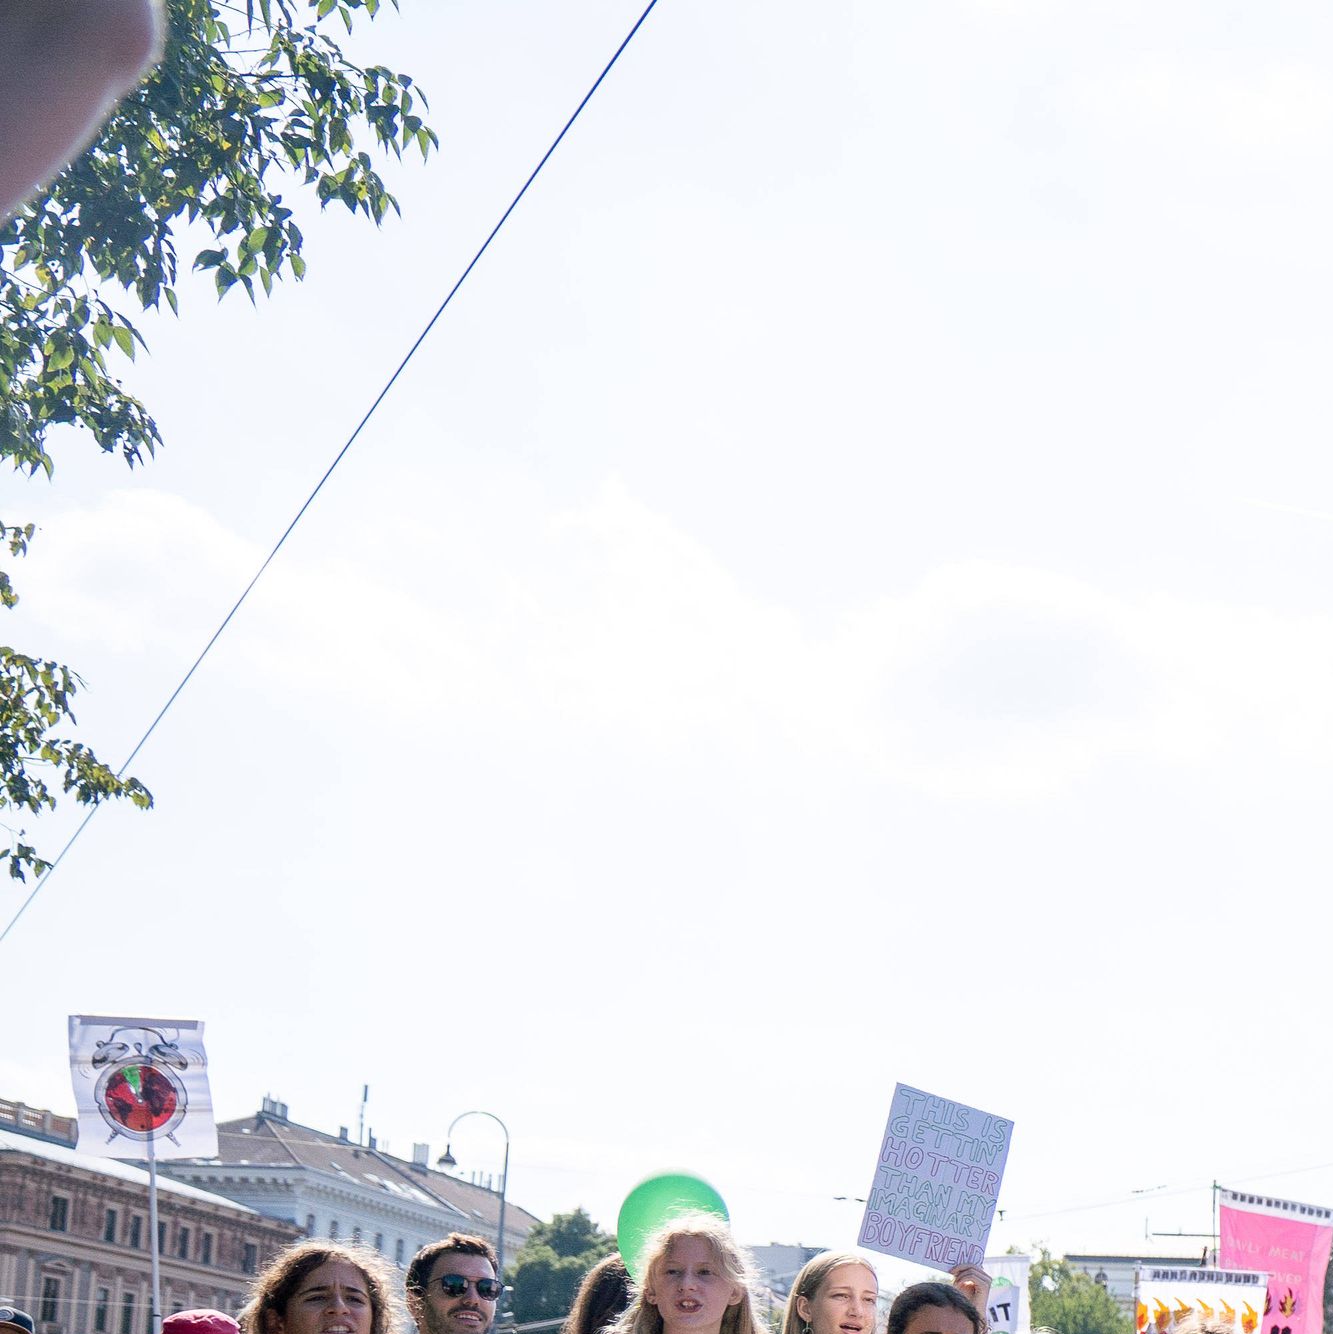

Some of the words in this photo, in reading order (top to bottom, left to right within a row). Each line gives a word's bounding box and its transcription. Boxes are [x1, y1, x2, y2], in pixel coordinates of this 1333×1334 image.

[891, 1115, 1003, 1166] GETTIN'
[900, 1088, 970, 1131] THIS
[982, 1115, 1008, 1143] IS
[881, 1136, 1000, 1195] HOTTER
[868, 1187, 992, 1241] IMAGINARY
[879, 1166, 953, 1208] THAN
[957, 1190, 997, 1220] MY
[862, 1211, 984, 1265] BOYFRIEND
